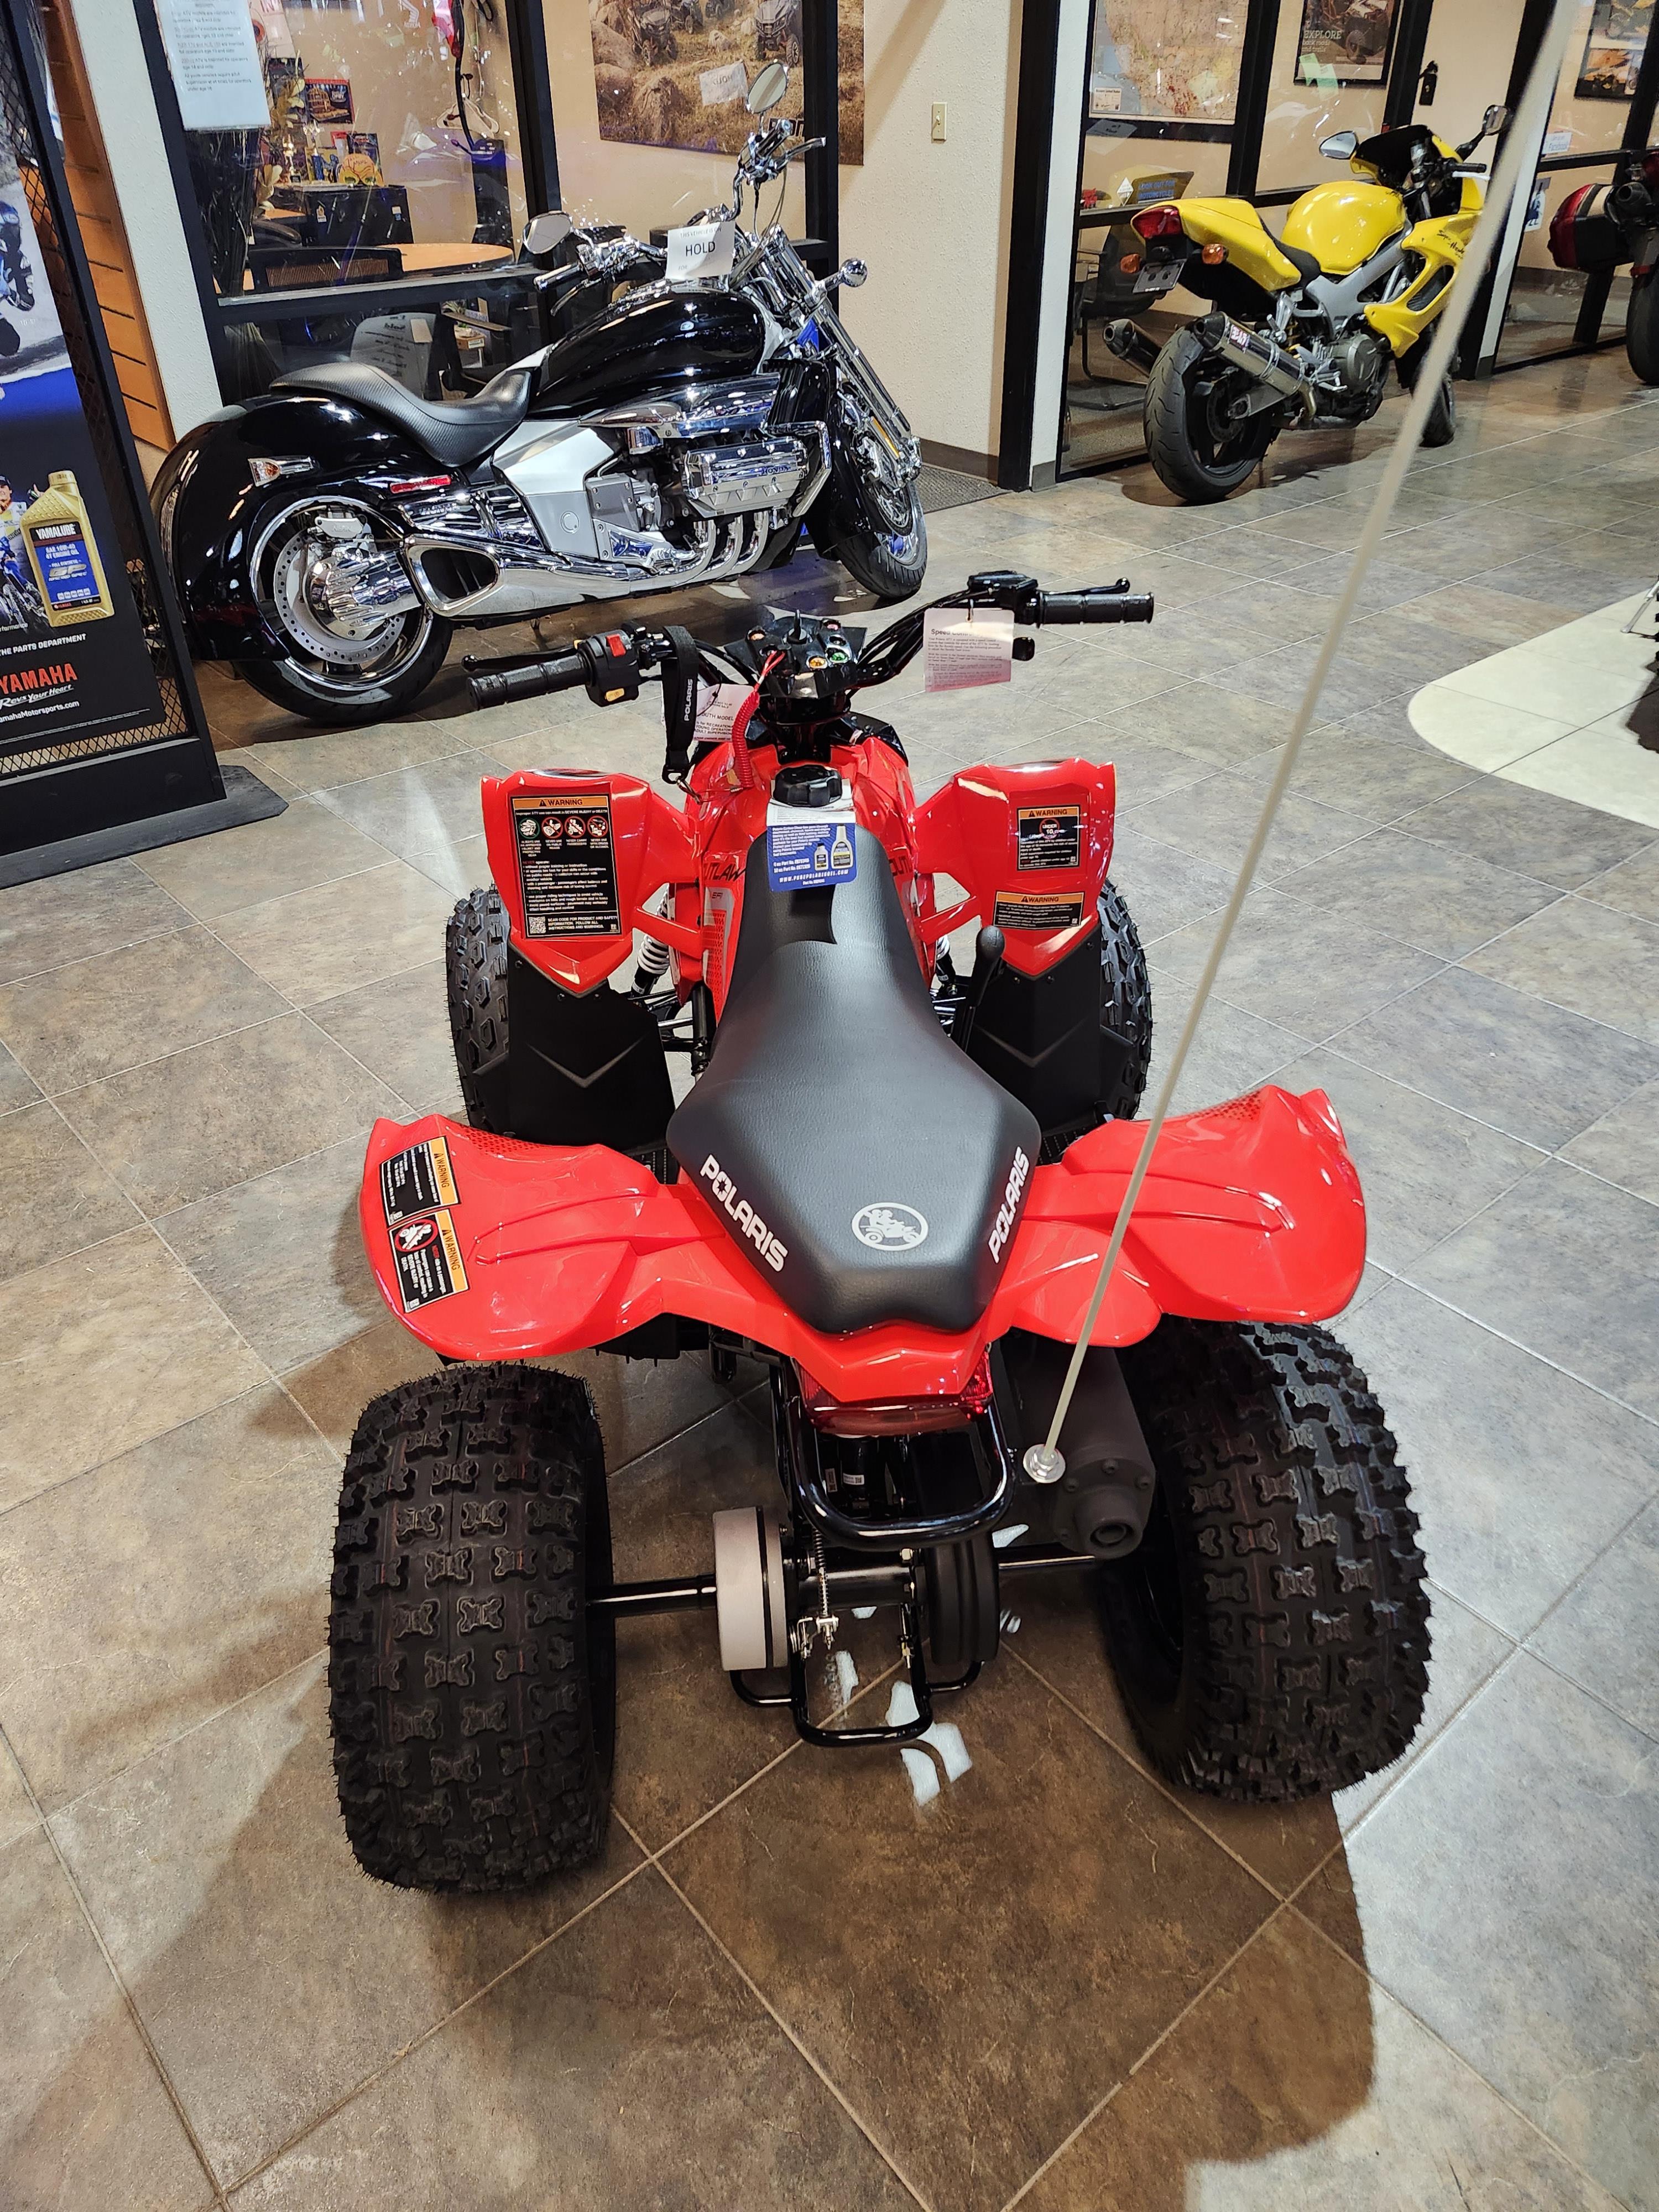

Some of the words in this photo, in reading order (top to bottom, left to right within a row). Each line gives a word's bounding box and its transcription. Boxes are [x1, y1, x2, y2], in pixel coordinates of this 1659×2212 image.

[1304, 30, 1342, 39] EXPLORE
[1139, 181, 1153, 190] LOOK
[1154, 180, 1165, 189] OUT
[1165, 178, 1176, 187] FOR
[685, 241, 716, 257] HOLD
[761, 466, 791, 474] HONDA
[35, 523, 76, 540] YAMALUBE
[13, 643, 36, 654] PARTS
[38, 633, 87, 649] DEPARTMENT
[0, 663, 78, 695] YAMAHA
[684, 679, 693, 722] POLARIS
[703, 862, 747, 881] UTLAW
[436, 1158, 450, 1188] WARNING
[700, 1154, 789, 1272] POLARIS
[988, 1146, 1029, 1264] POLARIS
[445, 1236, 460, 1270] WARNING
